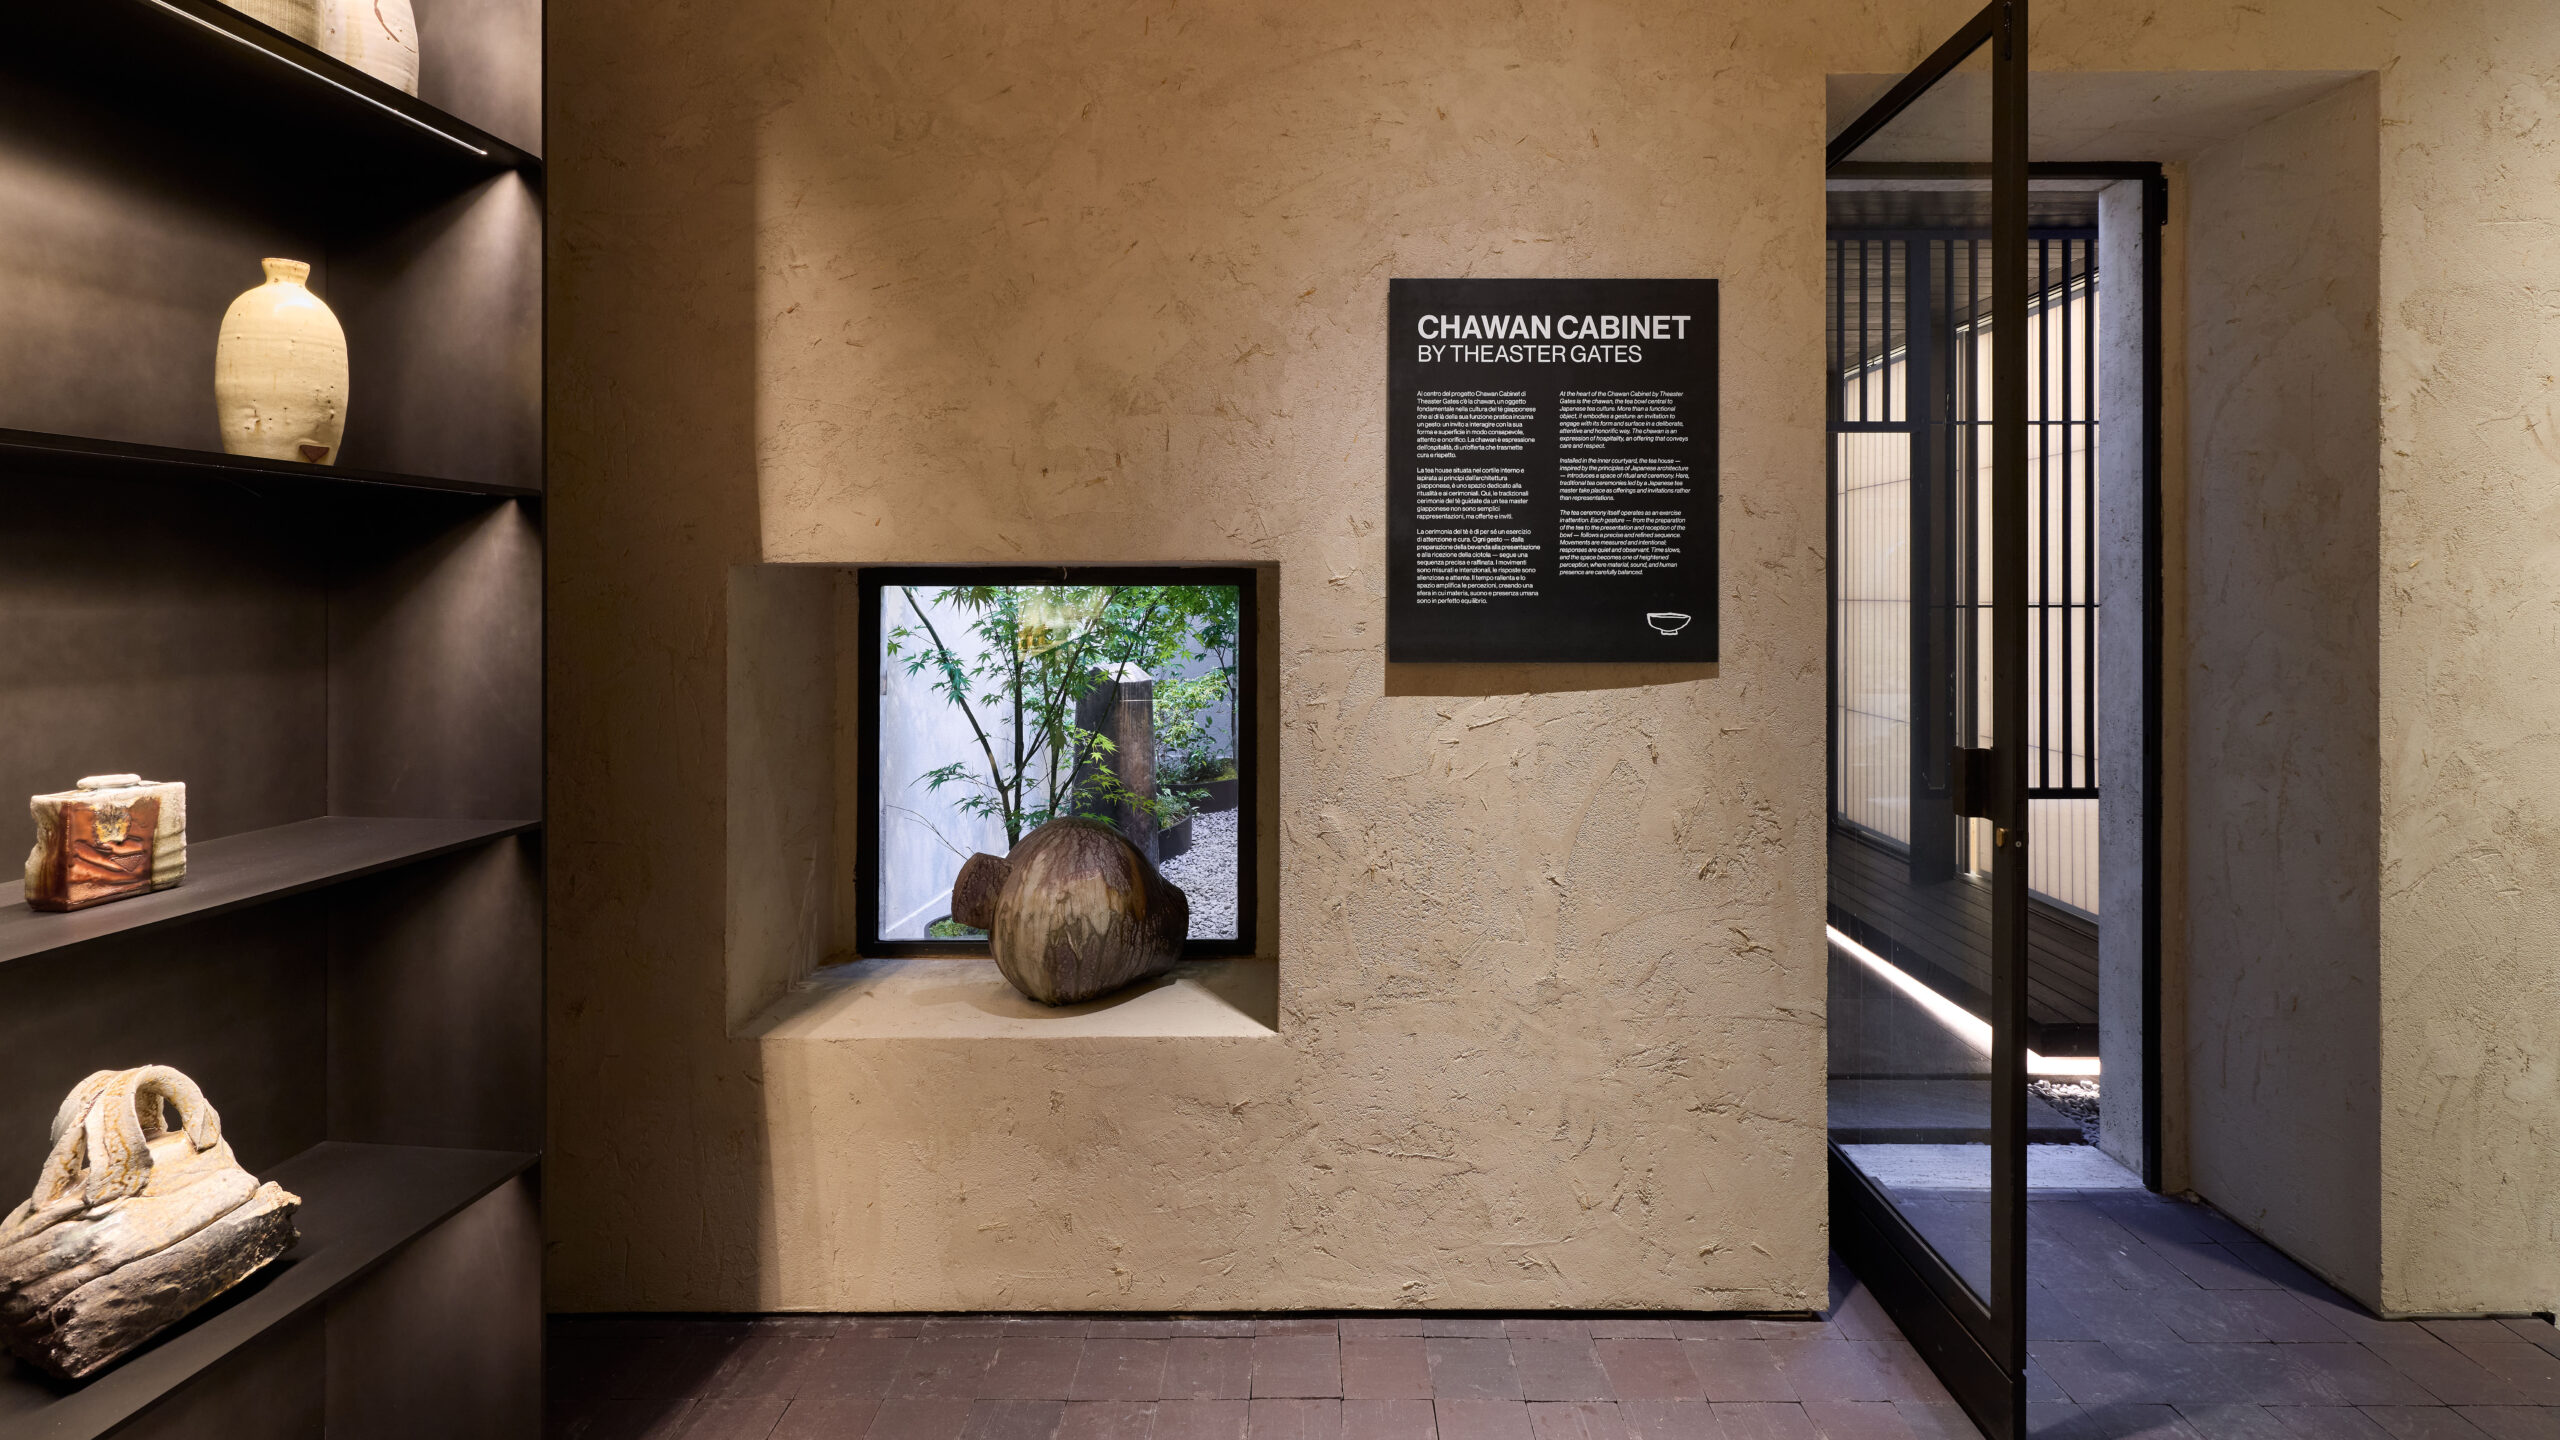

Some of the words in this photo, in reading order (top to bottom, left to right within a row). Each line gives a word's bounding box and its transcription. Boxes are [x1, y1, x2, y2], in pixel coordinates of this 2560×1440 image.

[1417, 314, 1550, 340] CHAWAN
[1556, 314, 1691, 340] CABINET
[1418, 345, 1446, 363] BY
[1450, 345, 1566, 363] THEASTER
[1570, 345, 1642, 363] GATES
[1504, 398, 1527, 406] oggetto
[1503, 406, 1536, 414] giapponese
[1560, 406, 1586, 414] Japanese
[1469, 421, 1496, 429] interagire
[1438, 429, 1466, 437] superficie
[1559, 435, 1590, 443] expression
[1633, 435, 1654, 443] offering
[1559, 465, 1581, 473] inspired
[1597, 465, 1624, 473] principles
[1631, 465, 1656, 473] Japanese
[1416, 475, 1438, 483] ispirata
[1443, 475, 1465, 483] principi
[1467, 482, 1486, 490] spazio
[1648, 480, 1674, 488] Japanese
[1612, 487, 1636, 495] offerings
[1461, 498, 1483, 506] guidate
[1416, 505, 1450, 513] giapponese
[1476, 505, 1501, 513] semplici
[1620, 510, 1644, 518] operates
[1604, 517, 1625, 525] gesture
[1654, 517, 1686, 525] preparation
[1600, 525, 1634, 533] presentation
[1644, 525, 1670, 533] reception
[1486, 536, 1503, 544] gesto
[1603, 532, 1624, 540] precise
[1416, 544, 1454, 552] preparazione
[1501, 544, 1541, 552] presentazione
[1639, 554, 1669, 562] heightened
[1444, 559, 1466, 567] precisa
[1498, 567, 1521, 575] risposte
[1594, 569, 1617, 577] carefully
[1416, 582, 1436, 590] spazio
[1436, 582, 1461, 590] amplifica
